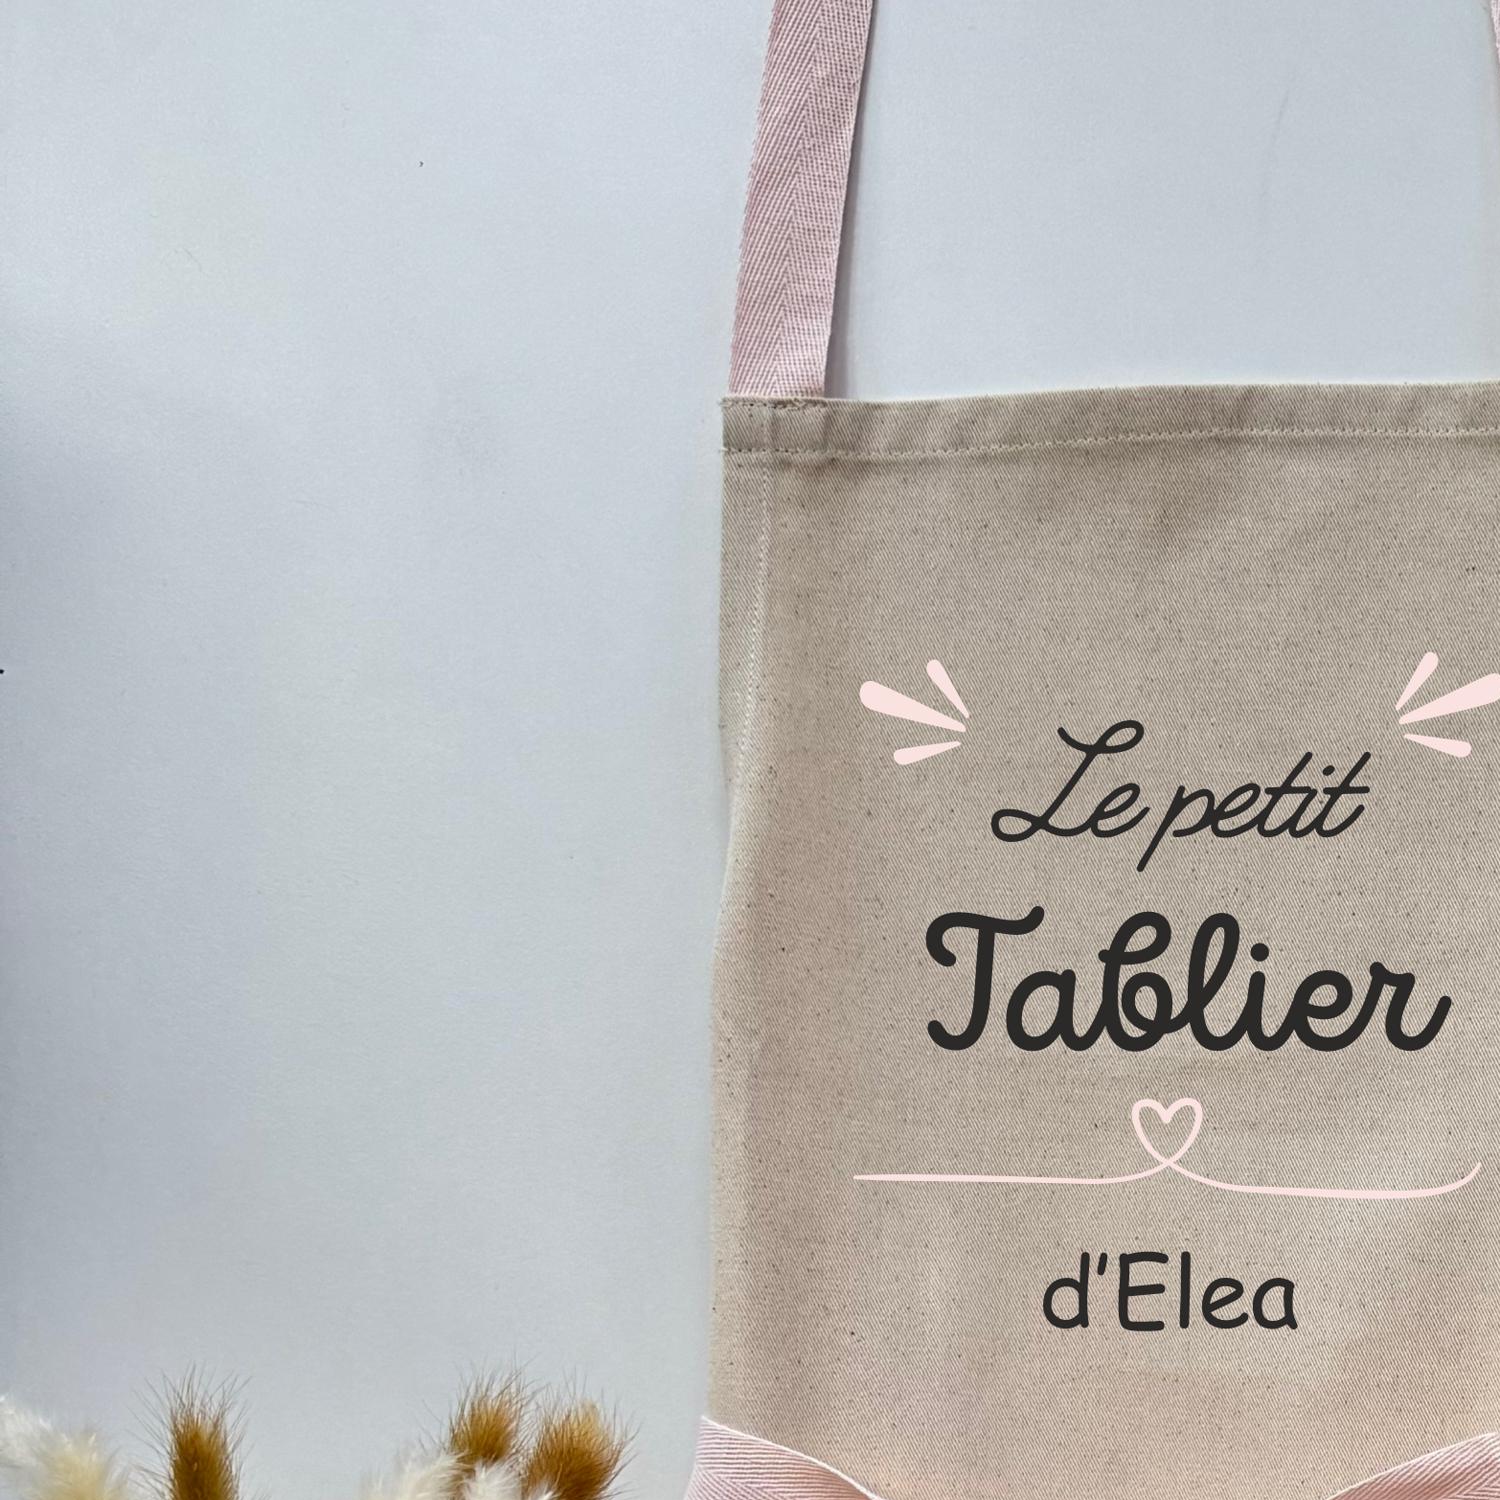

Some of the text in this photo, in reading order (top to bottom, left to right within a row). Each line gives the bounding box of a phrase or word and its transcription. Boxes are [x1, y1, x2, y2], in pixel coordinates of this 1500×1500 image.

[990, 719, 1372, 873] Le petit
[925, 905, 1452, 1053] Tablier
[1042, 1251, 1298, 1332] d'Elea
